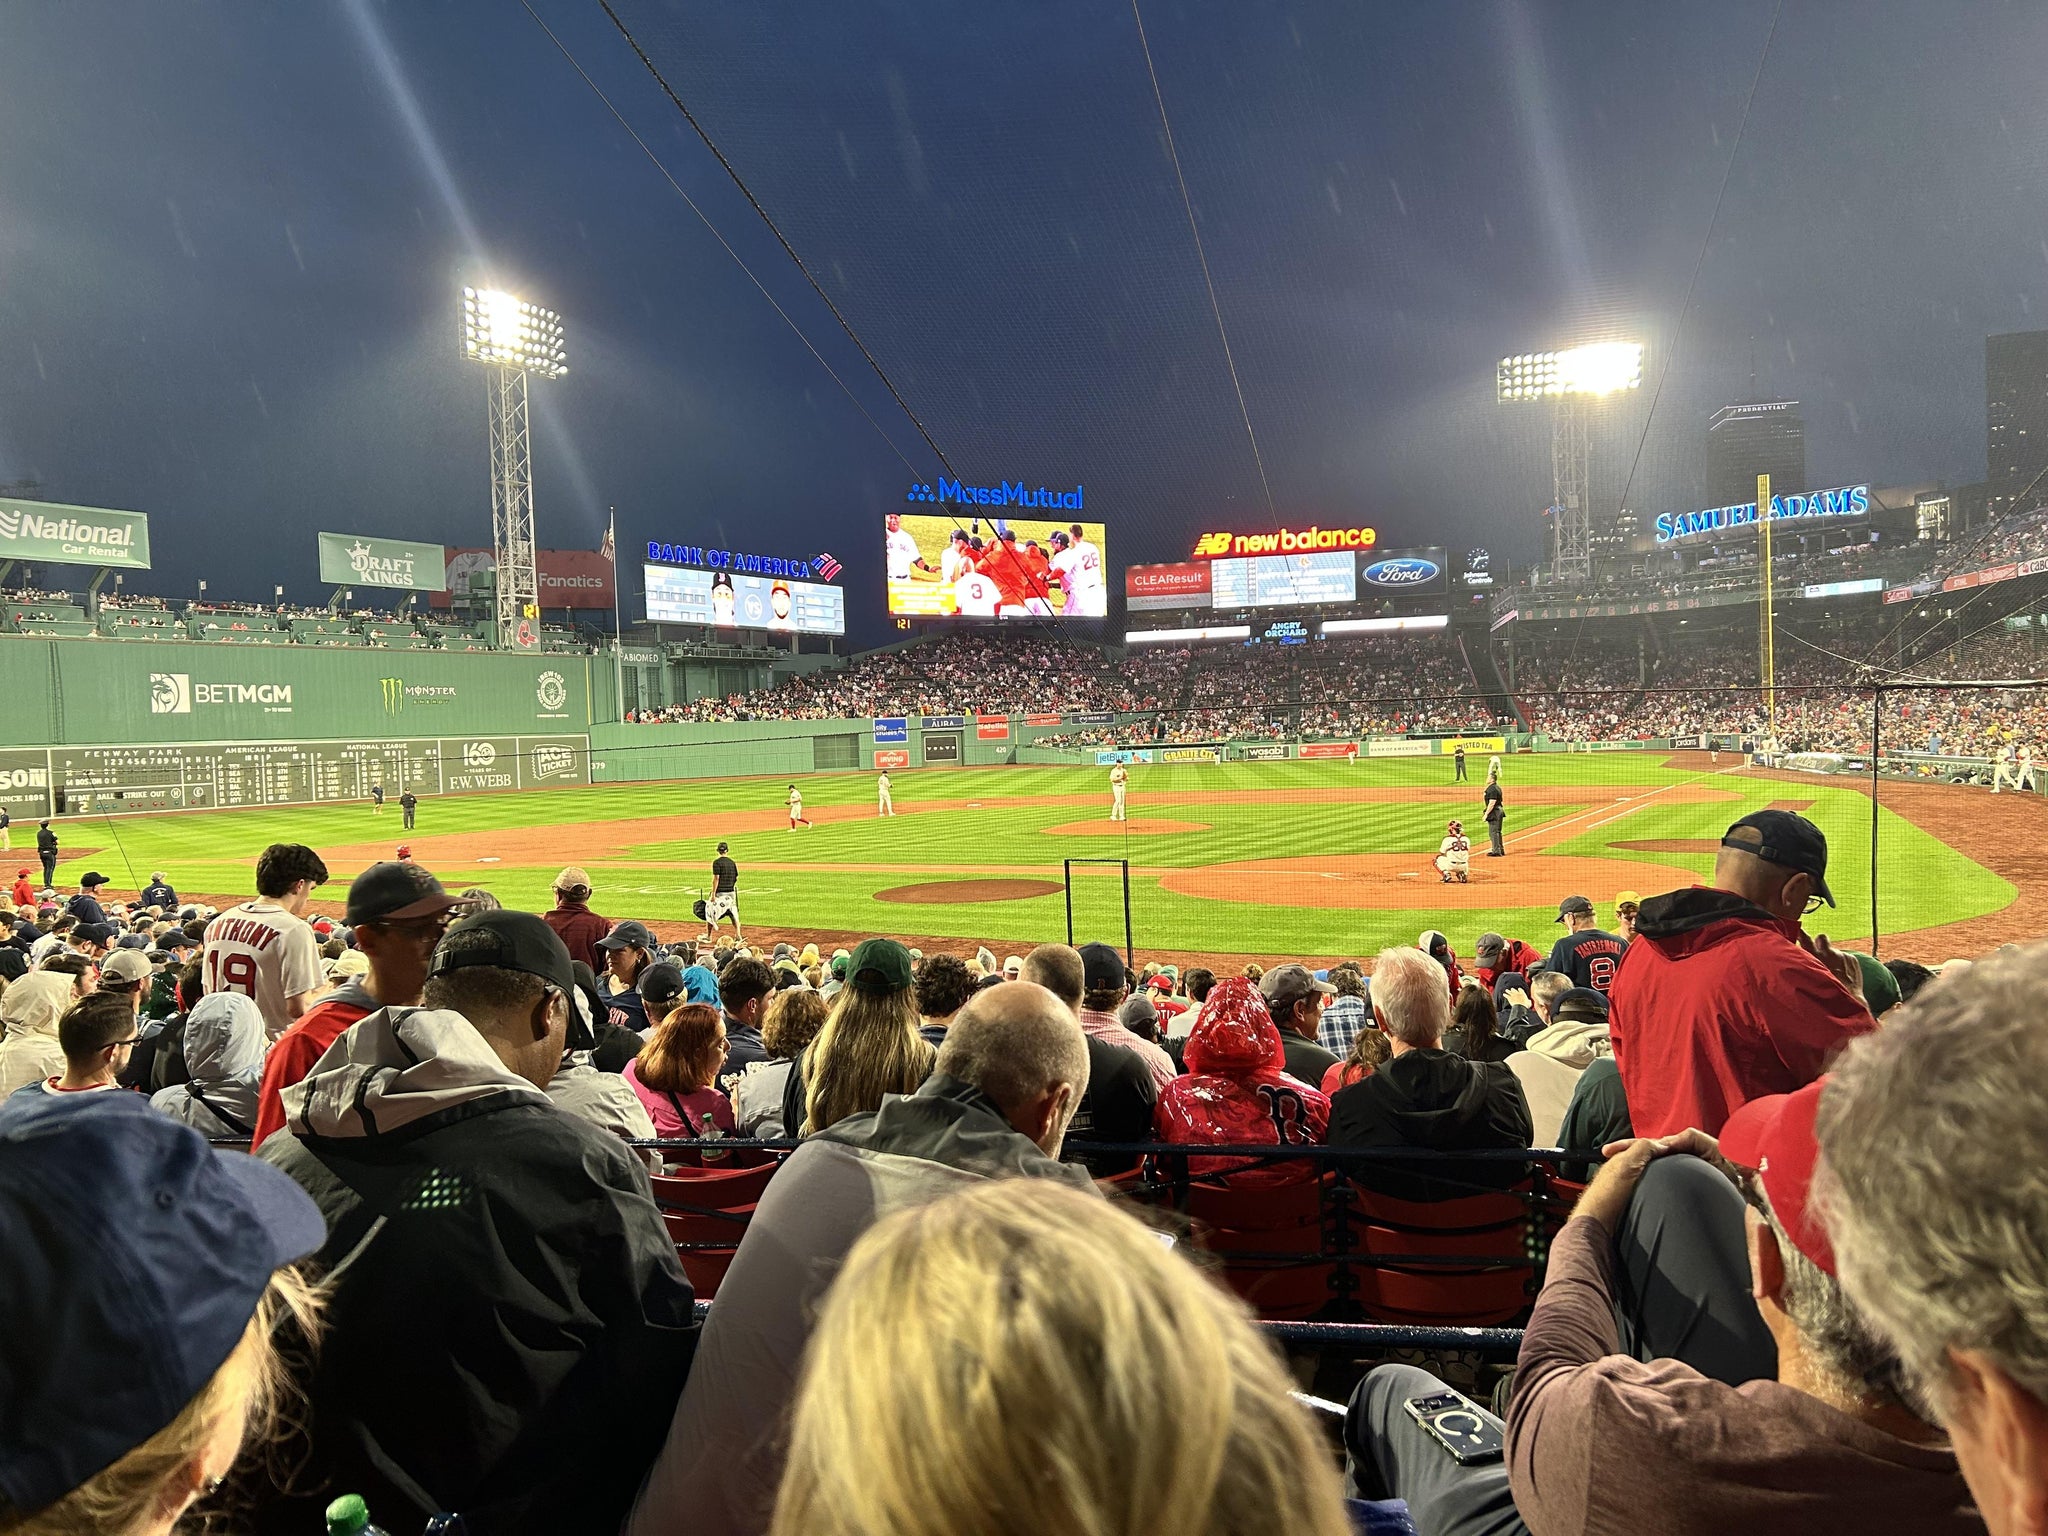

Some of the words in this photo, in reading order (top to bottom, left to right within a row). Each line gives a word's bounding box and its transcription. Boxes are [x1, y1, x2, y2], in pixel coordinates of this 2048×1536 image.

[1737, 404, 1785, 413] PRUDENTIAL
[939, 476, 1084, 510] MassMutual
[1655, 502, 1761, 543] SAMUEL
[1767, 486, 1868, 522] ADAMS
[1235, 534, 1279, 553] new
[1281, 526, 1376, 550] balance
[62, 544, 84, 554] Car
[88, 546, 128, 558] Rental
[647, 540, 703, 566] BANK
[707, 549, 731, 568] OF
[734, 557, 811, 578] AMERICA
[350, 554, 414, 572] DRAFT
[360, 569, 414, 586] KINGS
[538, 573, 603, 588] Fanatics
[1378, 563, 1424, 582] Ford
[971, 584, 983, 600] 3
[1264, 628, 1308, 637] ORCHARD
[624, 653, 658, 662] ABIOMED
[194, 684, 292, 703] BETMGM
[405, 685, 456, 696] MONSTER
[538, 746, 572, 762] ACE
[1099, 752, 1128, 762] jetBlue
[1164, 750, 1199, 760] GRANITE
[1200, 750, 1216, 759] CIT
[1249, 747, 1284, 756] wasabi
[542, 759, 572, 772] TICKET
[475, 774, 512, 787] WEBB
[123, 791, 148, 799] STRIKE
[206, 918, 280, 951] ANTHONY
[1574, 939, 1622, 959] YASTRZEMSKI
[209, 950, 257, 1000] 19
[1590, 957, 1616, 991] 8
